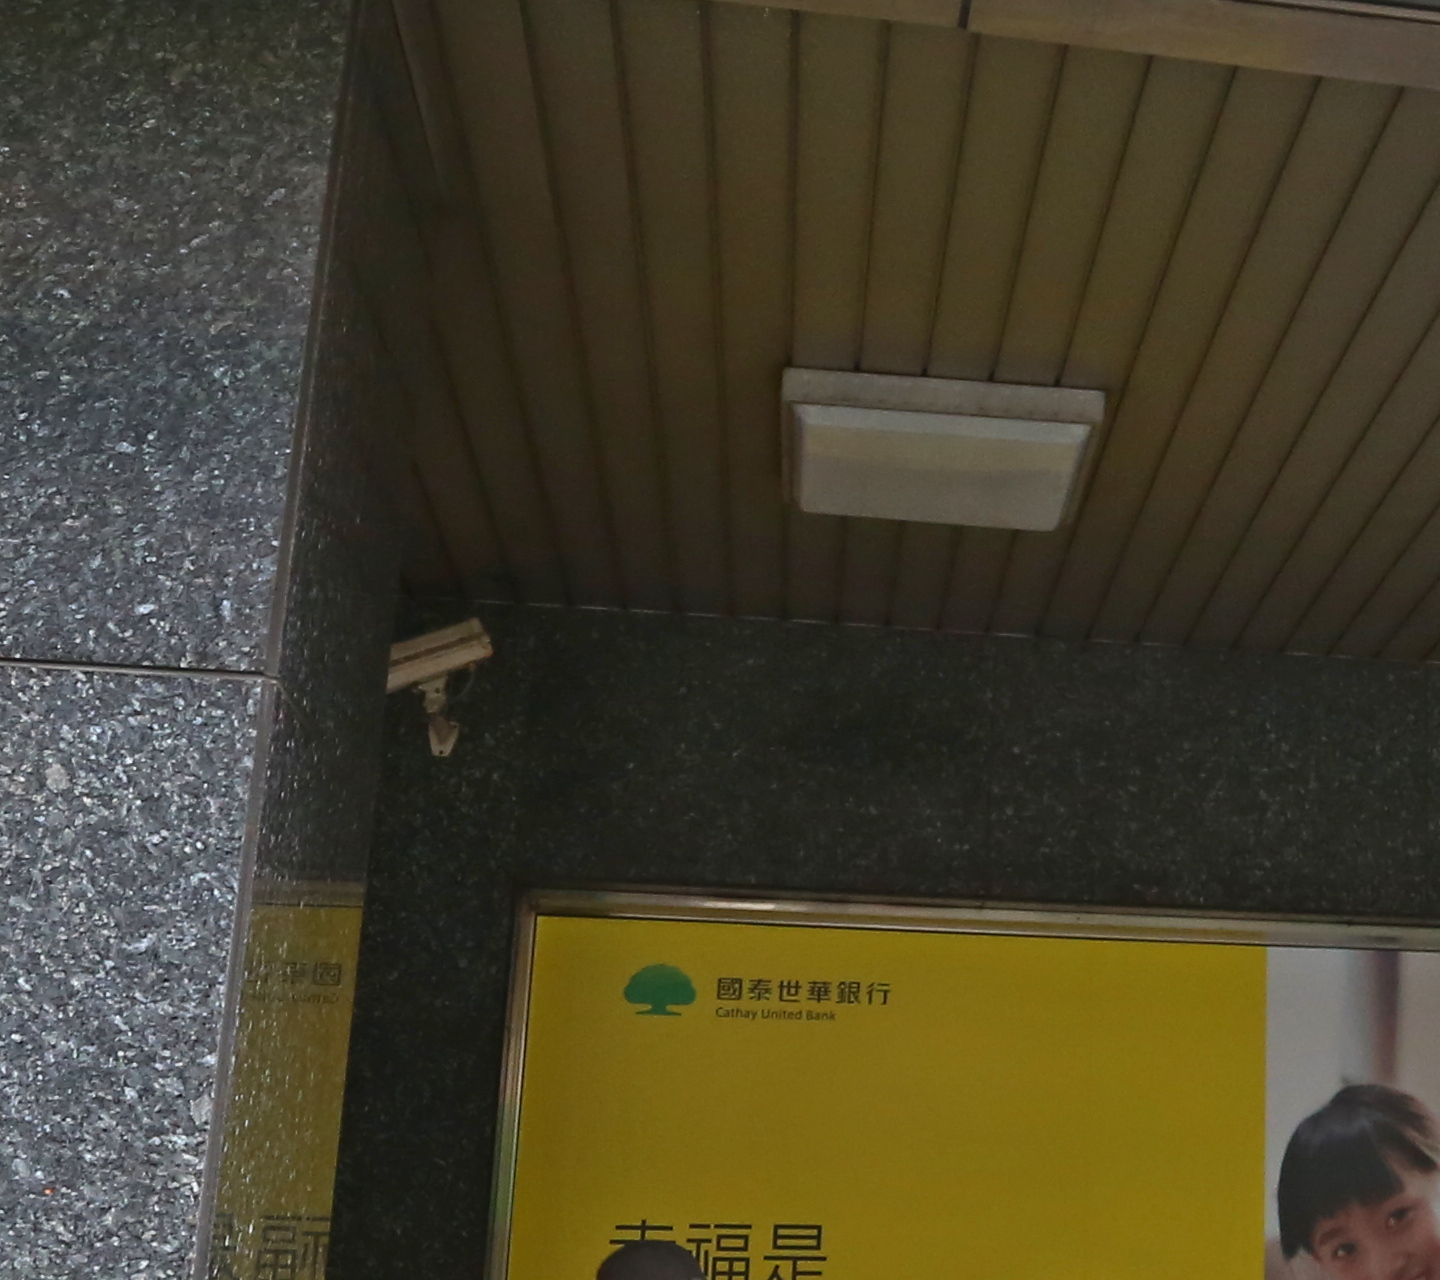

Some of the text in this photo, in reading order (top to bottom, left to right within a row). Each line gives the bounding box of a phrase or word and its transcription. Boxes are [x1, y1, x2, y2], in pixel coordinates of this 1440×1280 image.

[716, 976, 893, 1006] 國泰世華銀行
[715, 1006, 838, 1022] Cathay United Bank
